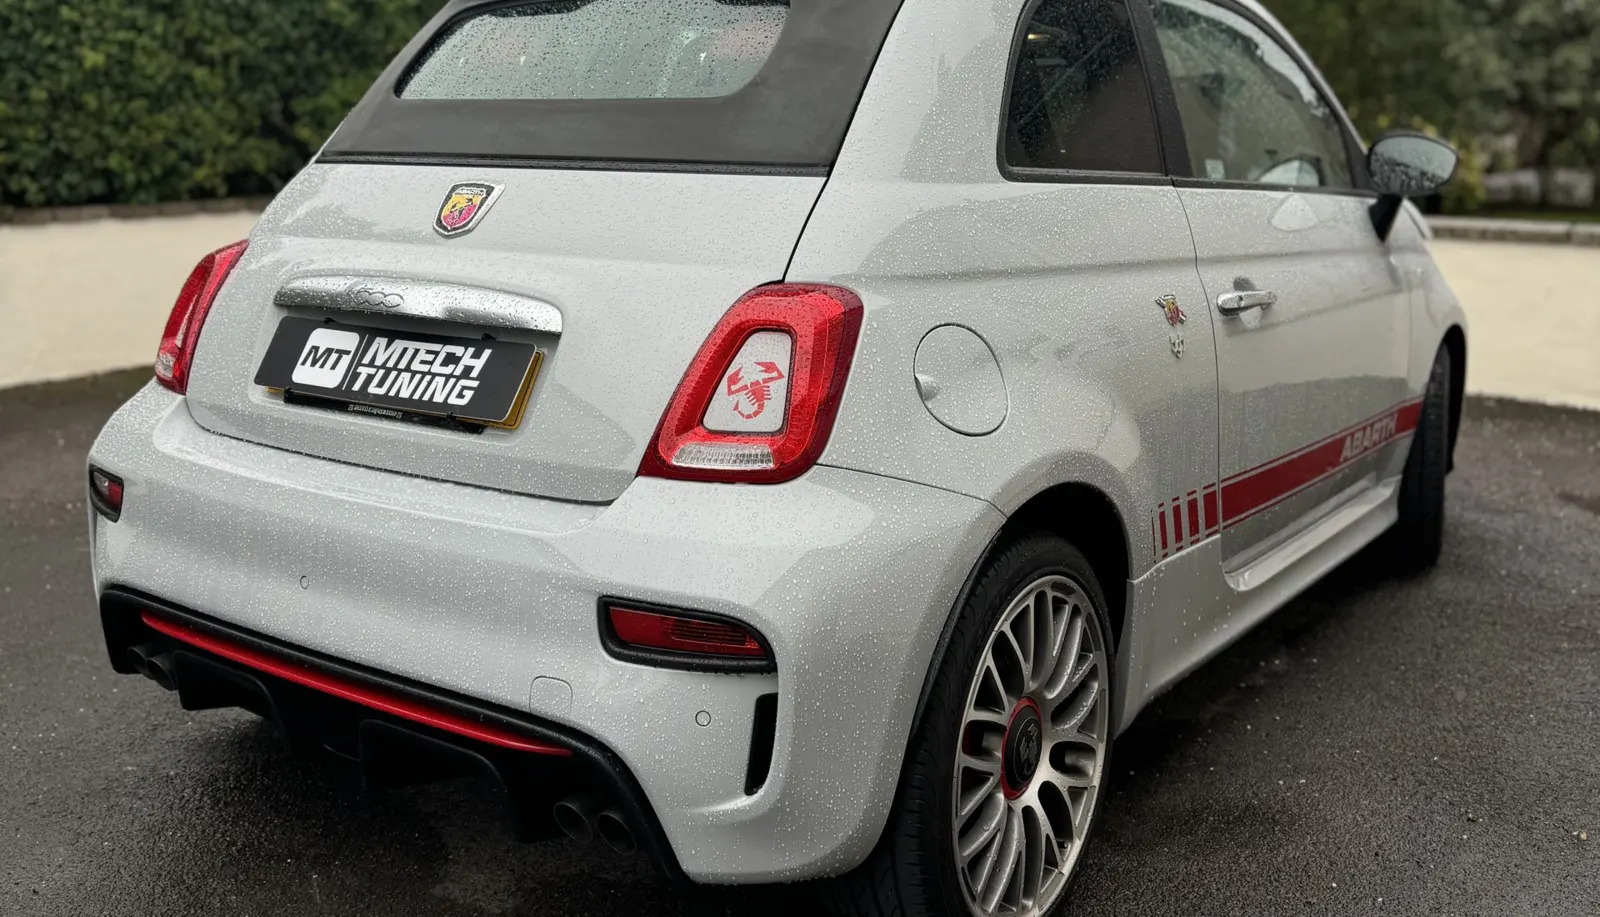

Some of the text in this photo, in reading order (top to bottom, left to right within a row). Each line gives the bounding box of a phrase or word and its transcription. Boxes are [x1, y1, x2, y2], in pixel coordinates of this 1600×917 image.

[300, 345, 352, 371] MT
[361, 336, 492, 378] MTECH
[351, 366, 480, 406] TUNING
